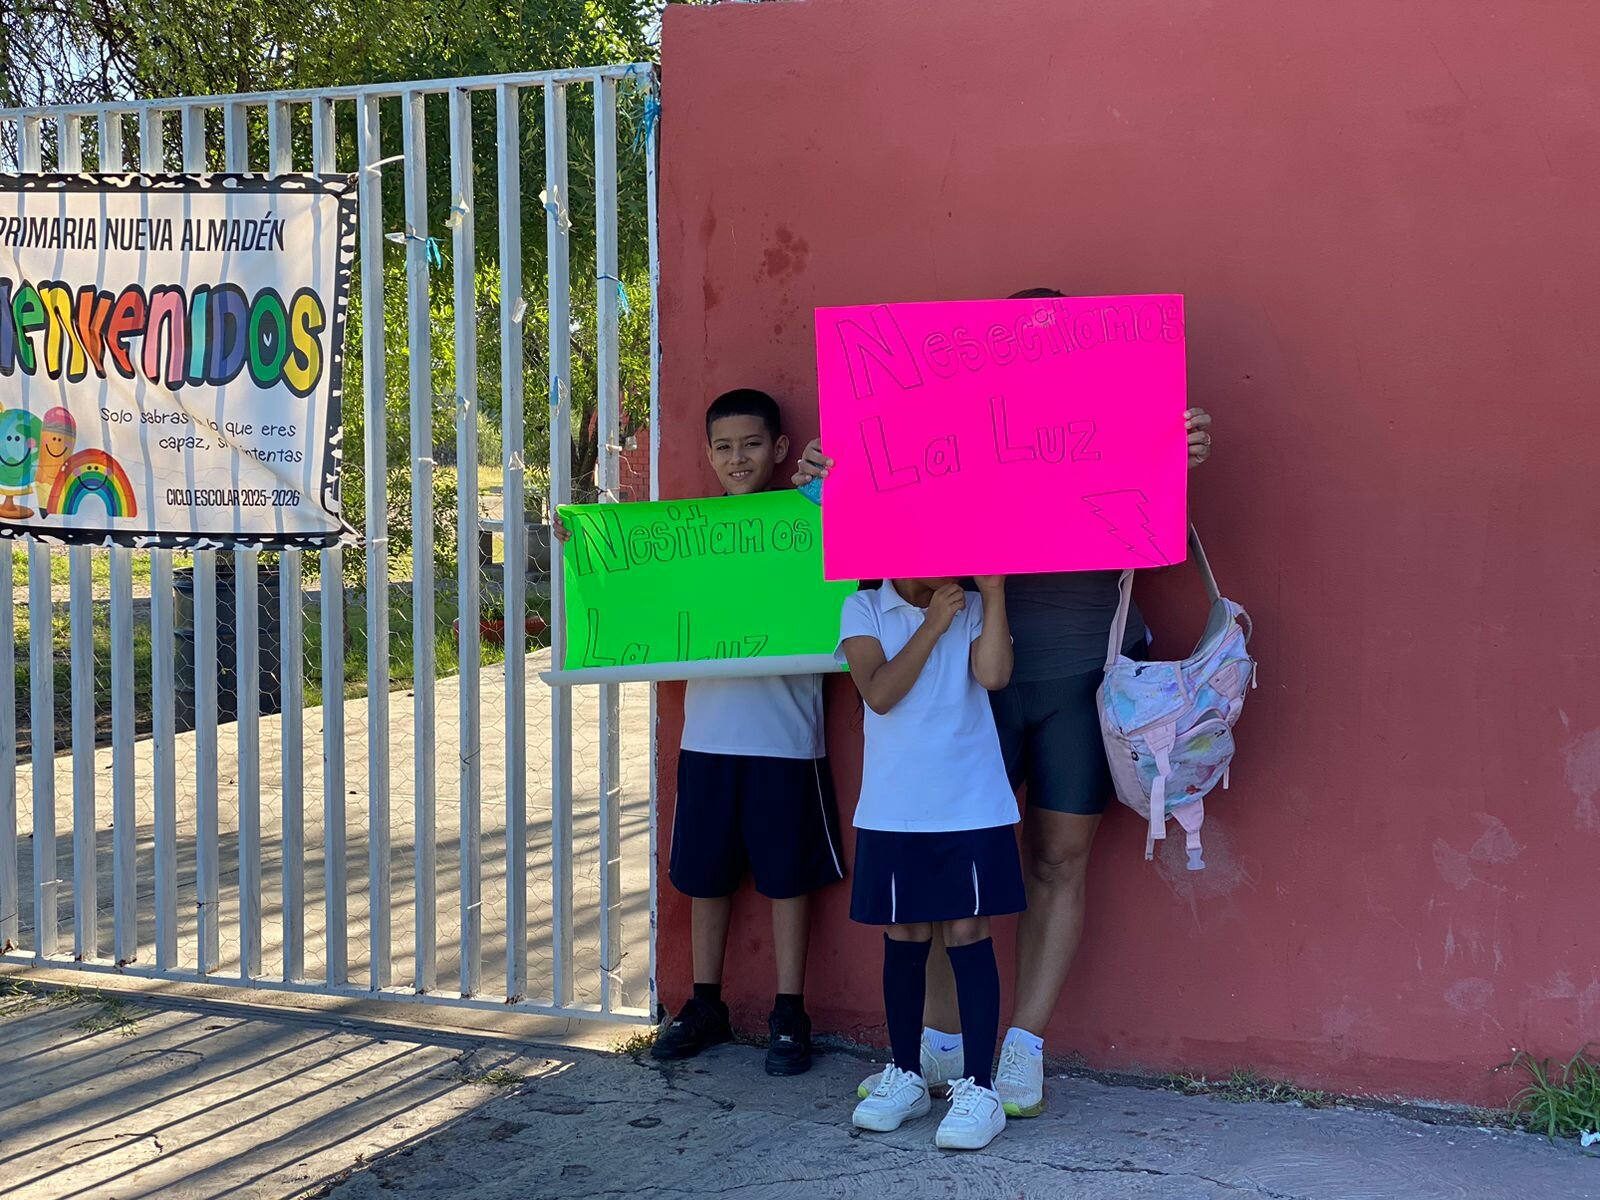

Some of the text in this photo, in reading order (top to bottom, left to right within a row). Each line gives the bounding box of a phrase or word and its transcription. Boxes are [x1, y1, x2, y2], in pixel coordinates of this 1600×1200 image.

[104, 217, 174, 251] NUEVA
[181, 211, 286, 252] ALMADÉN
[836, 298, 1186, 402] Nesecitamos
[100, 407, 133, 425] Solo
[140, 409, 189, 425] sabras
[225, 421, 253, 437] que
[261, 424, 297, 437] eres
[158, 436, 210, 453] capaz,
[860, 415, 961, 493] La
[166, 488, 300, 506] CICLO ESCOLAR 2025-2026
[582, 607, 650, 668] La
